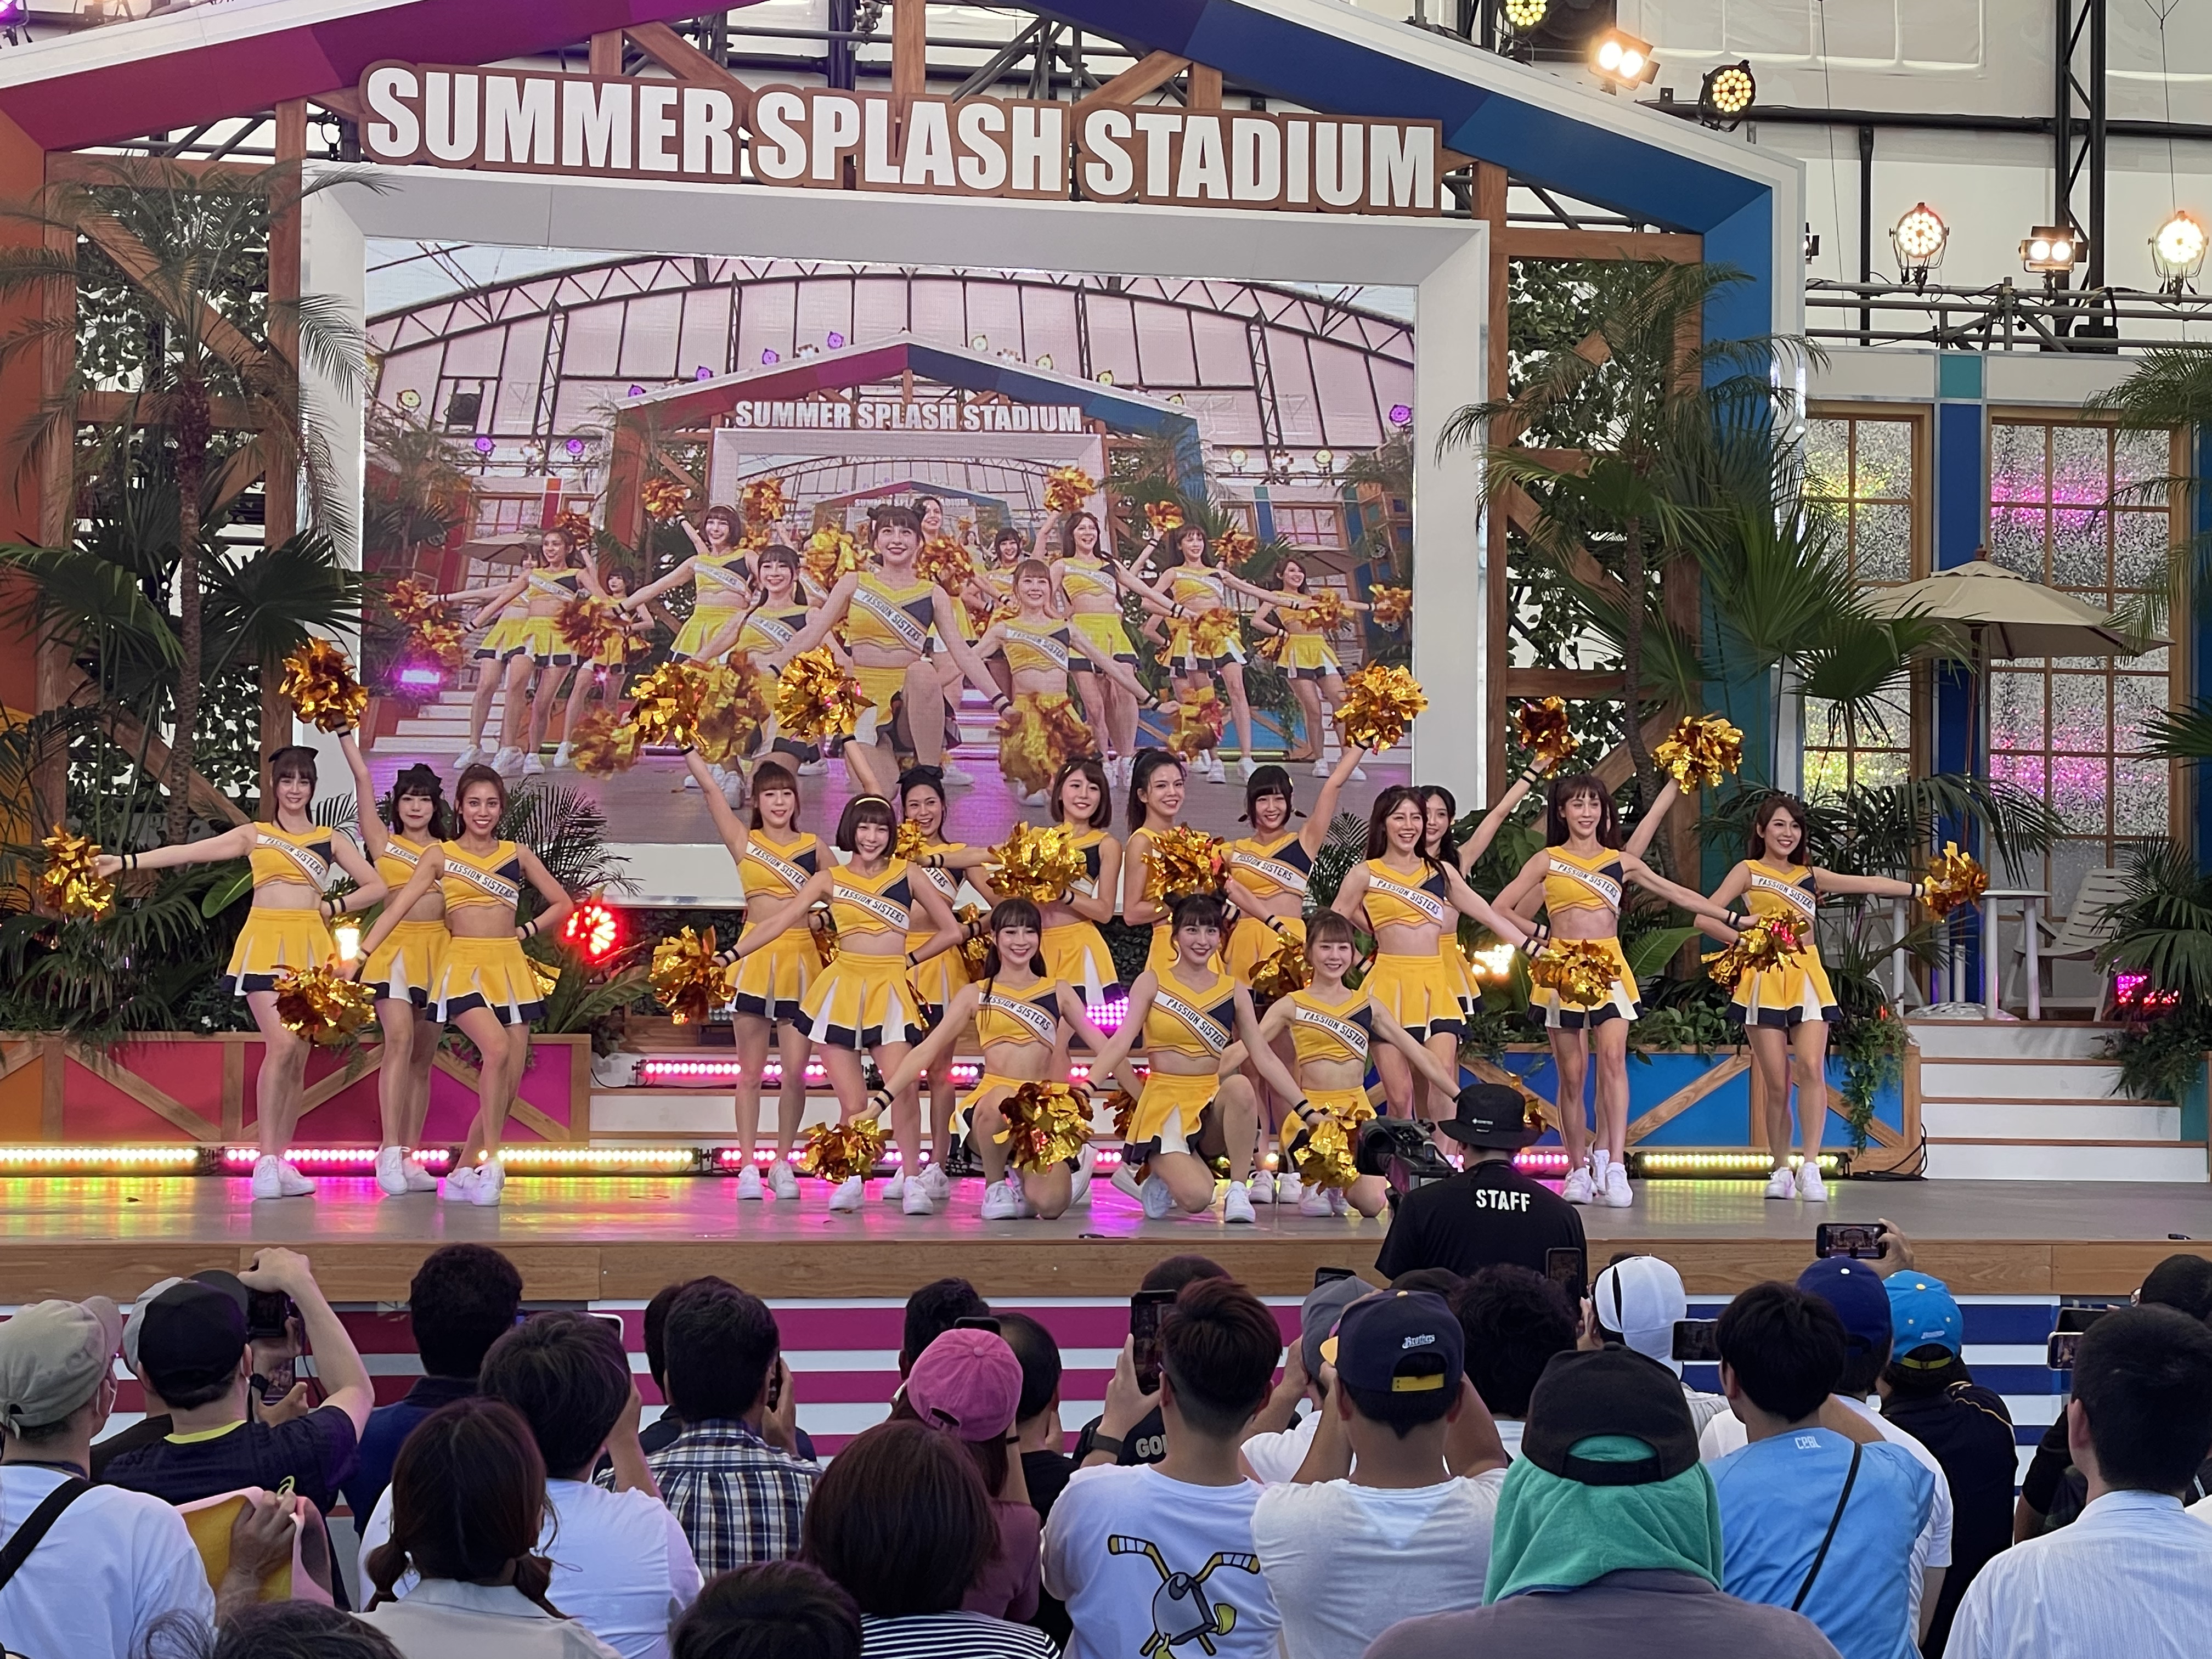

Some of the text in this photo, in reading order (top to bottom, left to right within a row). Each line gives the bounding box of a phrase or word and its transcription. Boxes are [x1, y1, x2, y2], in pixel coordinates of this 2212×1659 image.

[368, 67, 1434, 209] SUMMER SPLASH STADIUM
[736, 400, 1082, 432] SUMMER SPLASH STADIUM
[264, 838, 324, 875] PASSION SISTERS
[390, 846, 419, 862] PASSION
[751, 848, 807, 887] PASSION SISTER
[449, 862, 515, 898] PASSION SISTERS
[1261, 862, 1294, 881] SISTERS
[1558, 864, 1618, 898] PASSION SISTERS
[839, 888, 905, 923] PASSION SISTERS
[1376, 879, 1440, 915] PASSION SISTERS
[1758, 878, 1814, 909] PASSION SISTERS
[1016, 1005, 1051, 1031] SISTERS
[1166, 998, 1201, 1025] PASSION
[1304, 1012, 1367, 1050] PASSION SISTERS
[1476, 1189, 1531, 1212] STAFF
[1402, 1334, 1435, 1349] Brothers
[1795, 1435, 1821, 1449] CPBL
